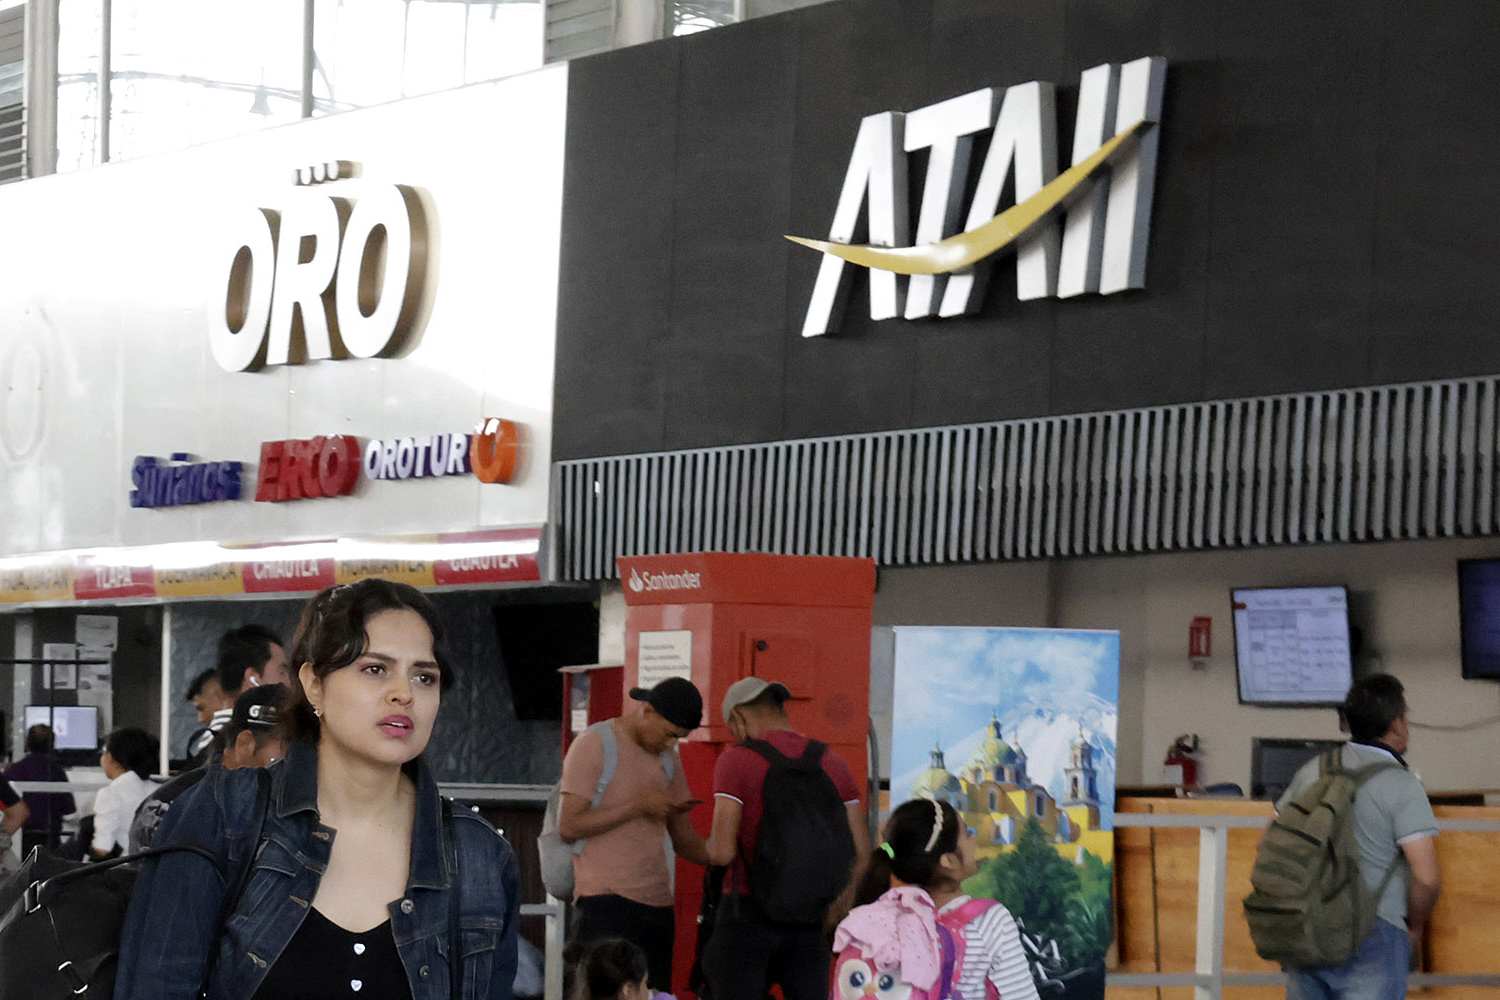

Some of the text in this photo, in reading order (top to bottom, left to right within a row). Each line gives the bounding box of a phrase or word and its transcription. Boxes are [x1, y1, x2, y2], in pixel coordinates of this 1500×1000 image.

[208, 184, 430, 373] ORO
[255, 434, 360, 502] ERCO
[364, 433, 471, 480] OROTUR
[642, 570, 701, 592] Santander
